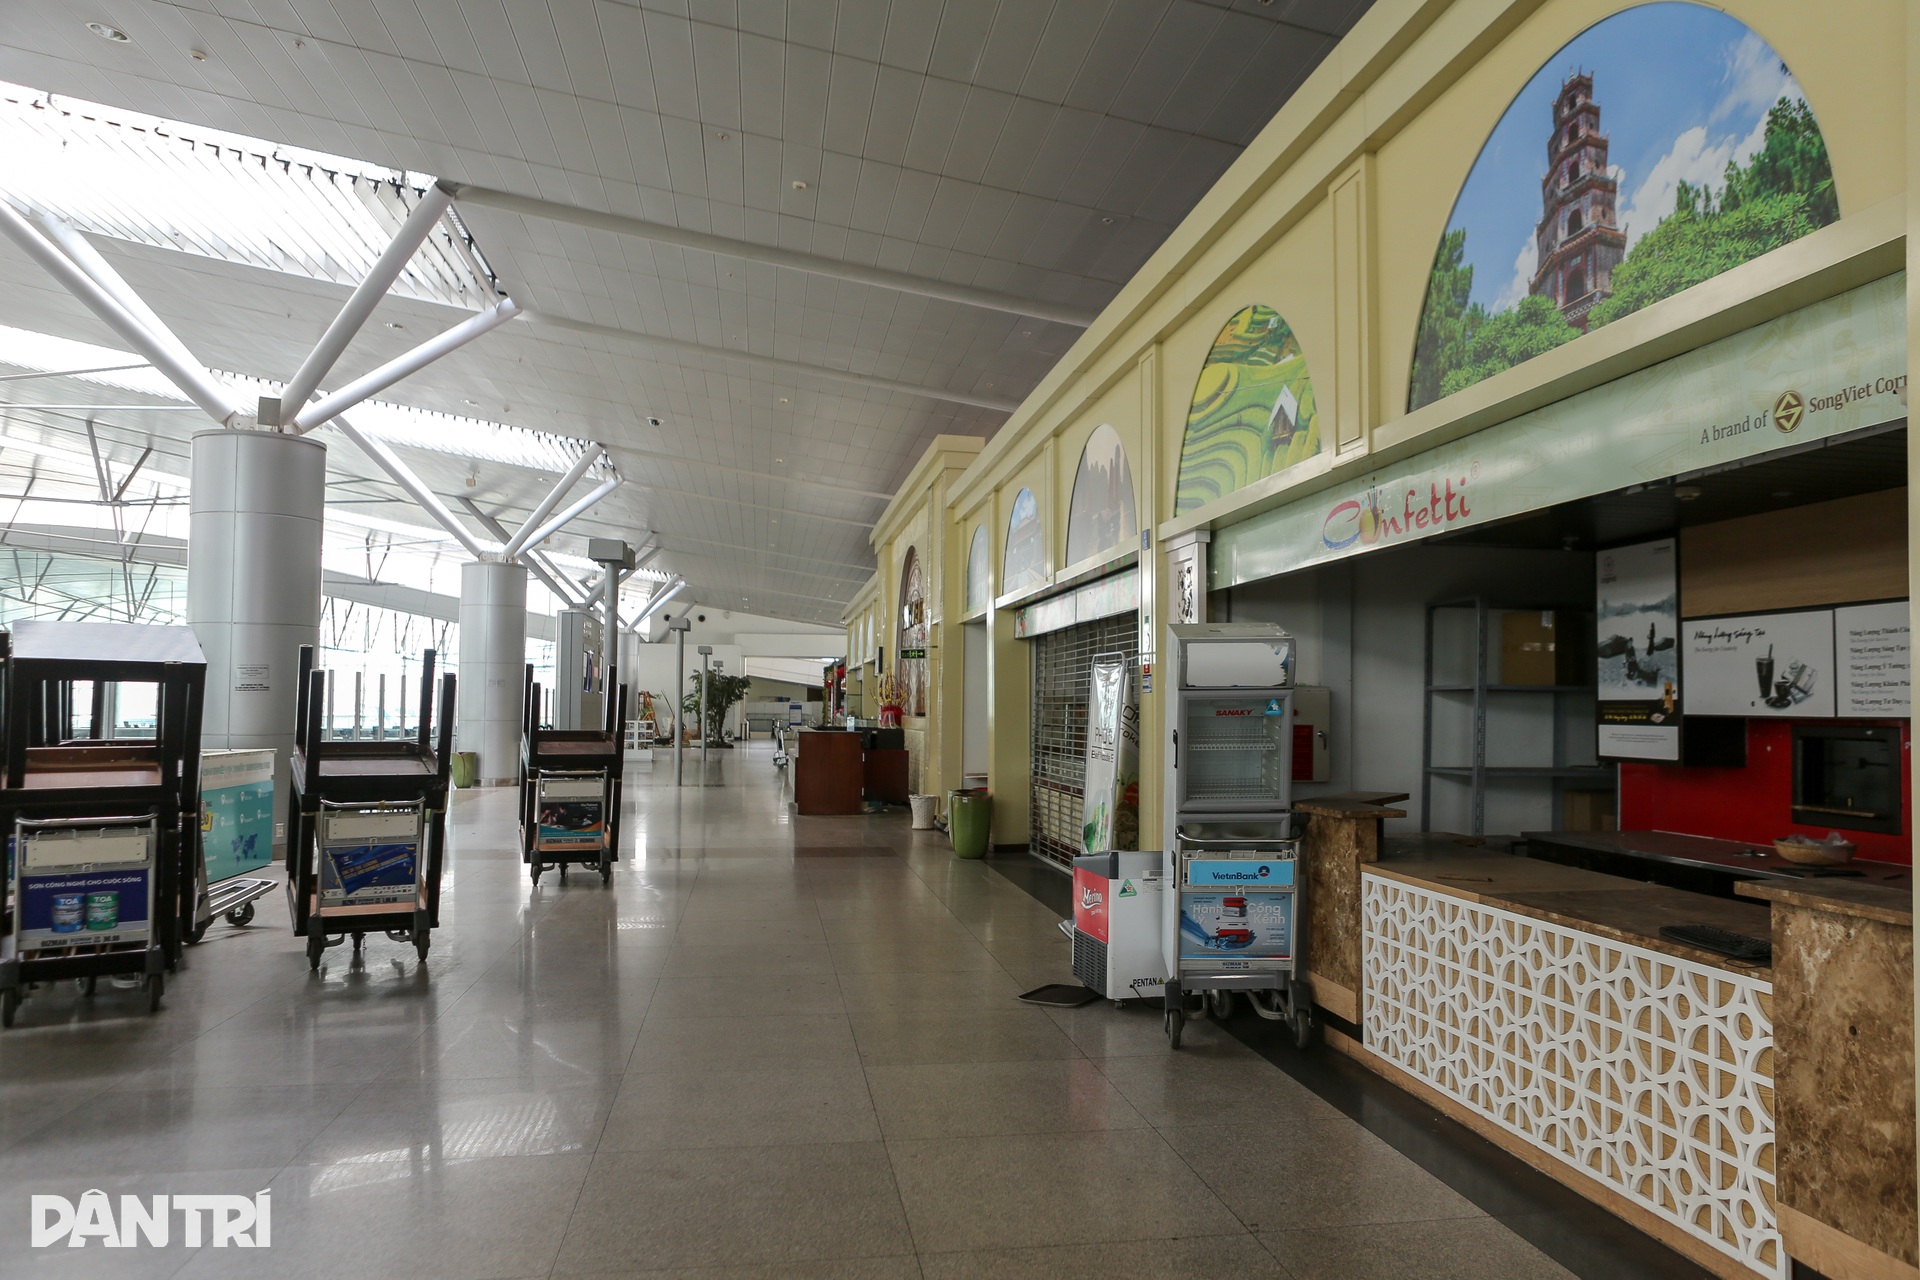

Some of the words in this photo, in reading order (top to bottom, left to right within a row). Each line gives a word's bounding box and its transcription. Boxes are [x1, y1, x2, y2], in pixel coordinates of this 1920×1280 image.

[1809, 382, 1872, 413] SongViet
[1700, 428, 1710, 445] A
[1713, 415, 1750, 441] brand
[1754, 409, 1769, 429] of
[1212, 872, 1259, 880] VietinBank
[94, 895, 112, 903] TOA
[1082, 886, 1103, 904] Merino
